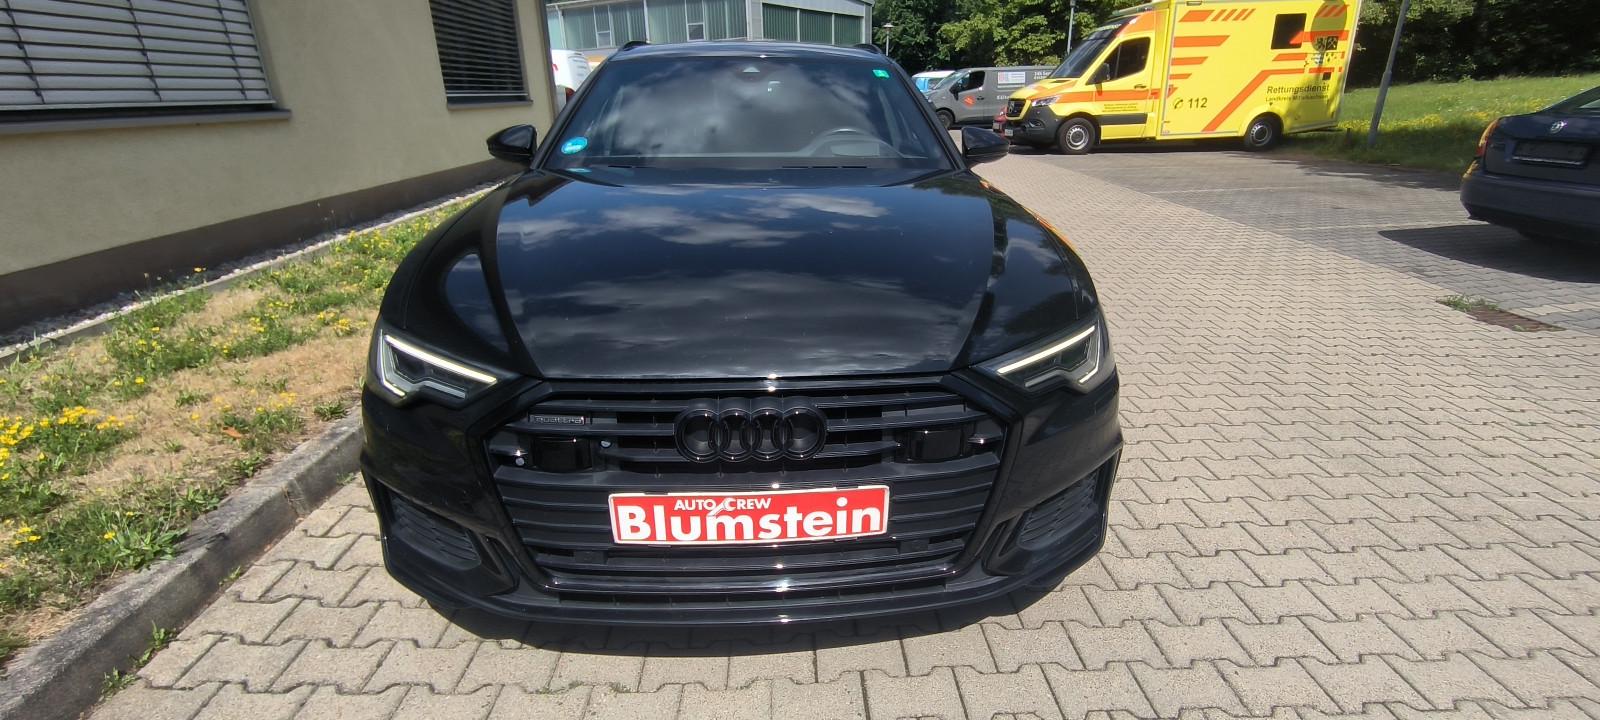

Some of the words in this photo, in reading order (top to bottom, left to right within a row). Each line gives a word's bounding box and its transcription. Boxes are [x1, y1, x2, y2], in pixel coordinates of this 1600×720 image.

[1267, 84, 1330, 94] Rettungsdienst
[1188, 97, 1208, 108] 112
[674, 499, 717, 511] AUTO
[725, 497, 771, 511] CREW
[617, 497, 881, 541] Blumstein
